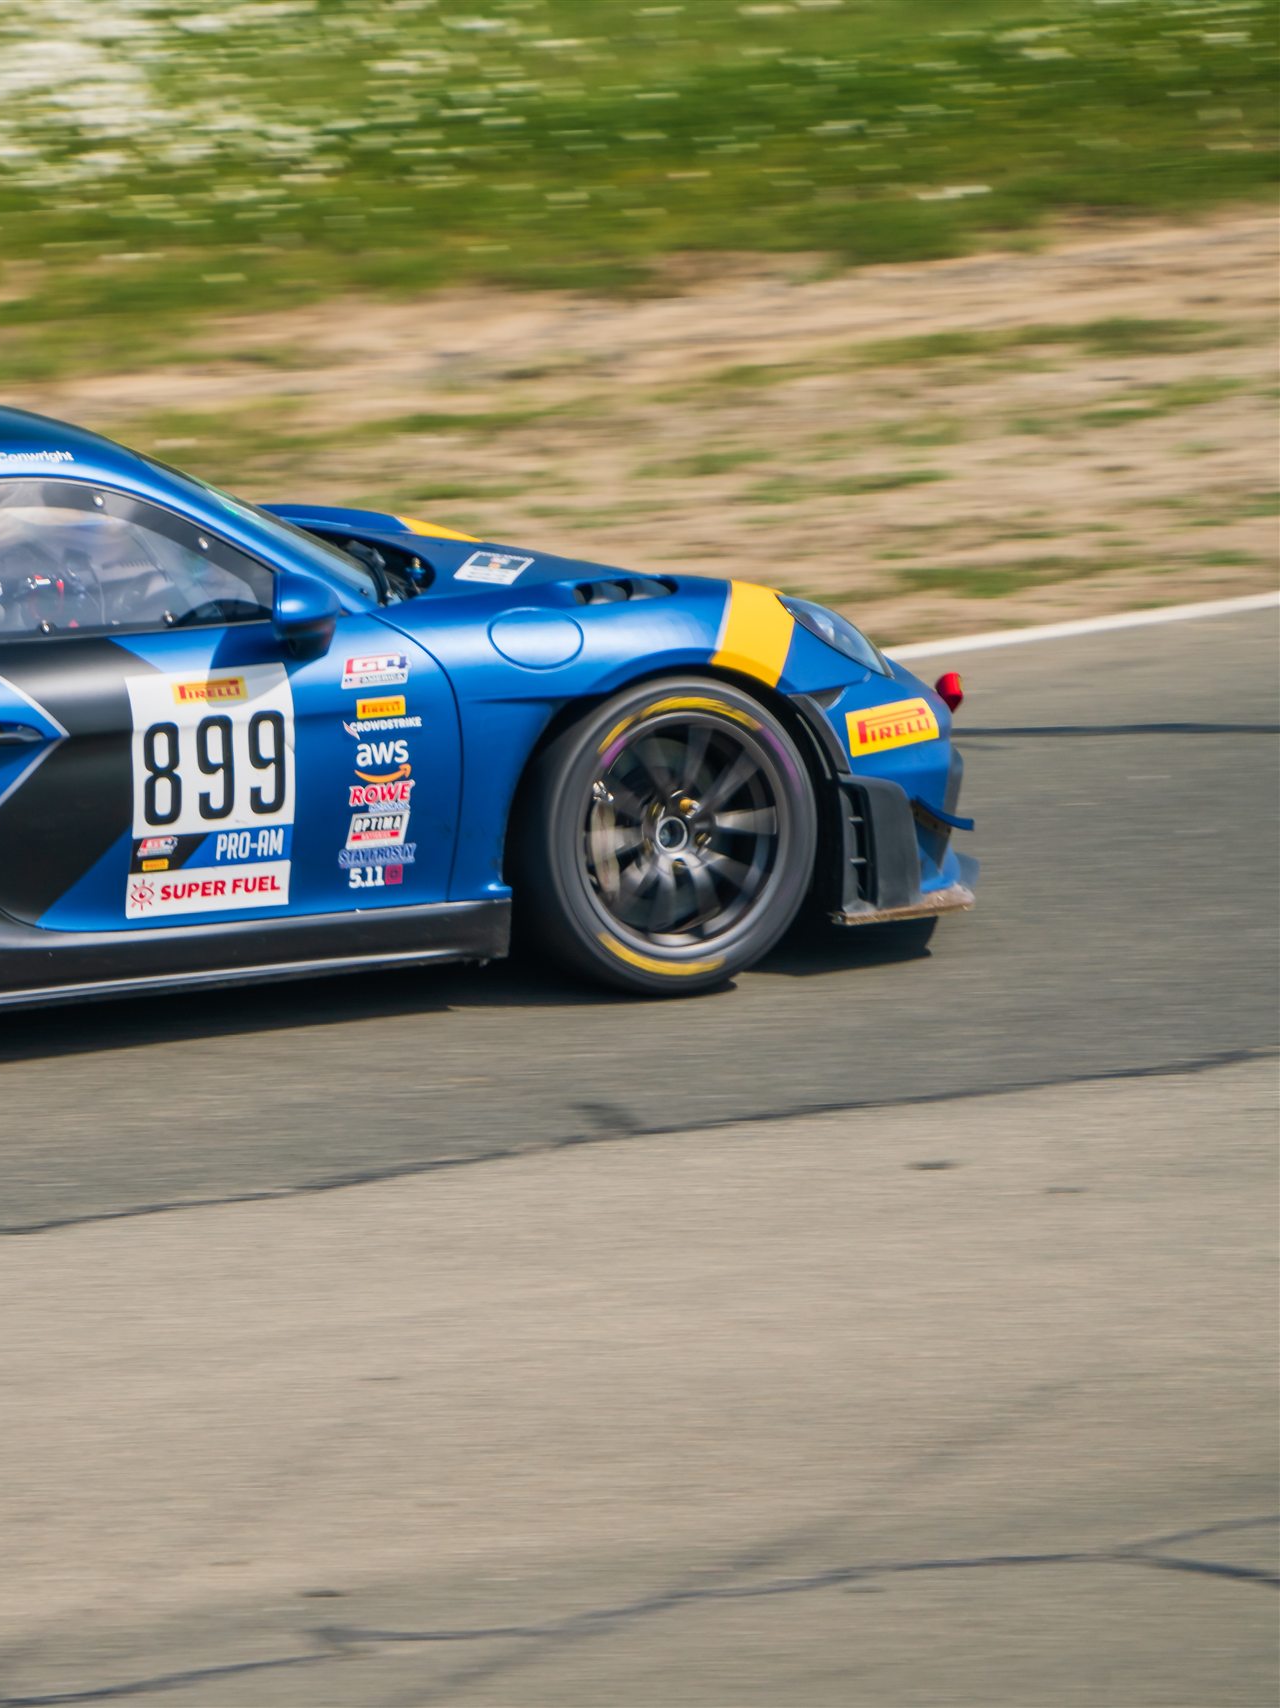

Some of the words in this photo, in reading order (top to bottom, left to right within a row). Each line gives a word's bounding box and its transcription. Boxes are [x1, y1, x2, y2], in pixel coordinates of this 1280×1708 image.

[177, 679, 241, 700] PIRELLI
[349, 717, 422, 733] CROWDSTRIKE
[857, 707, 930, 745] PIRELLI
[356, 740, 409, 767] aws
[144, 710, 286, 826] 899
[349, 780, 414, 806] ROWE
[353, 816, 401, 832] OPTIMA
[216, 827, 284, 861] PRO-AM
[160, 880, 227, 901] SUPER
[231, 875, 281, 895] FUEL
[349, 866, 385, 889] 5.11
